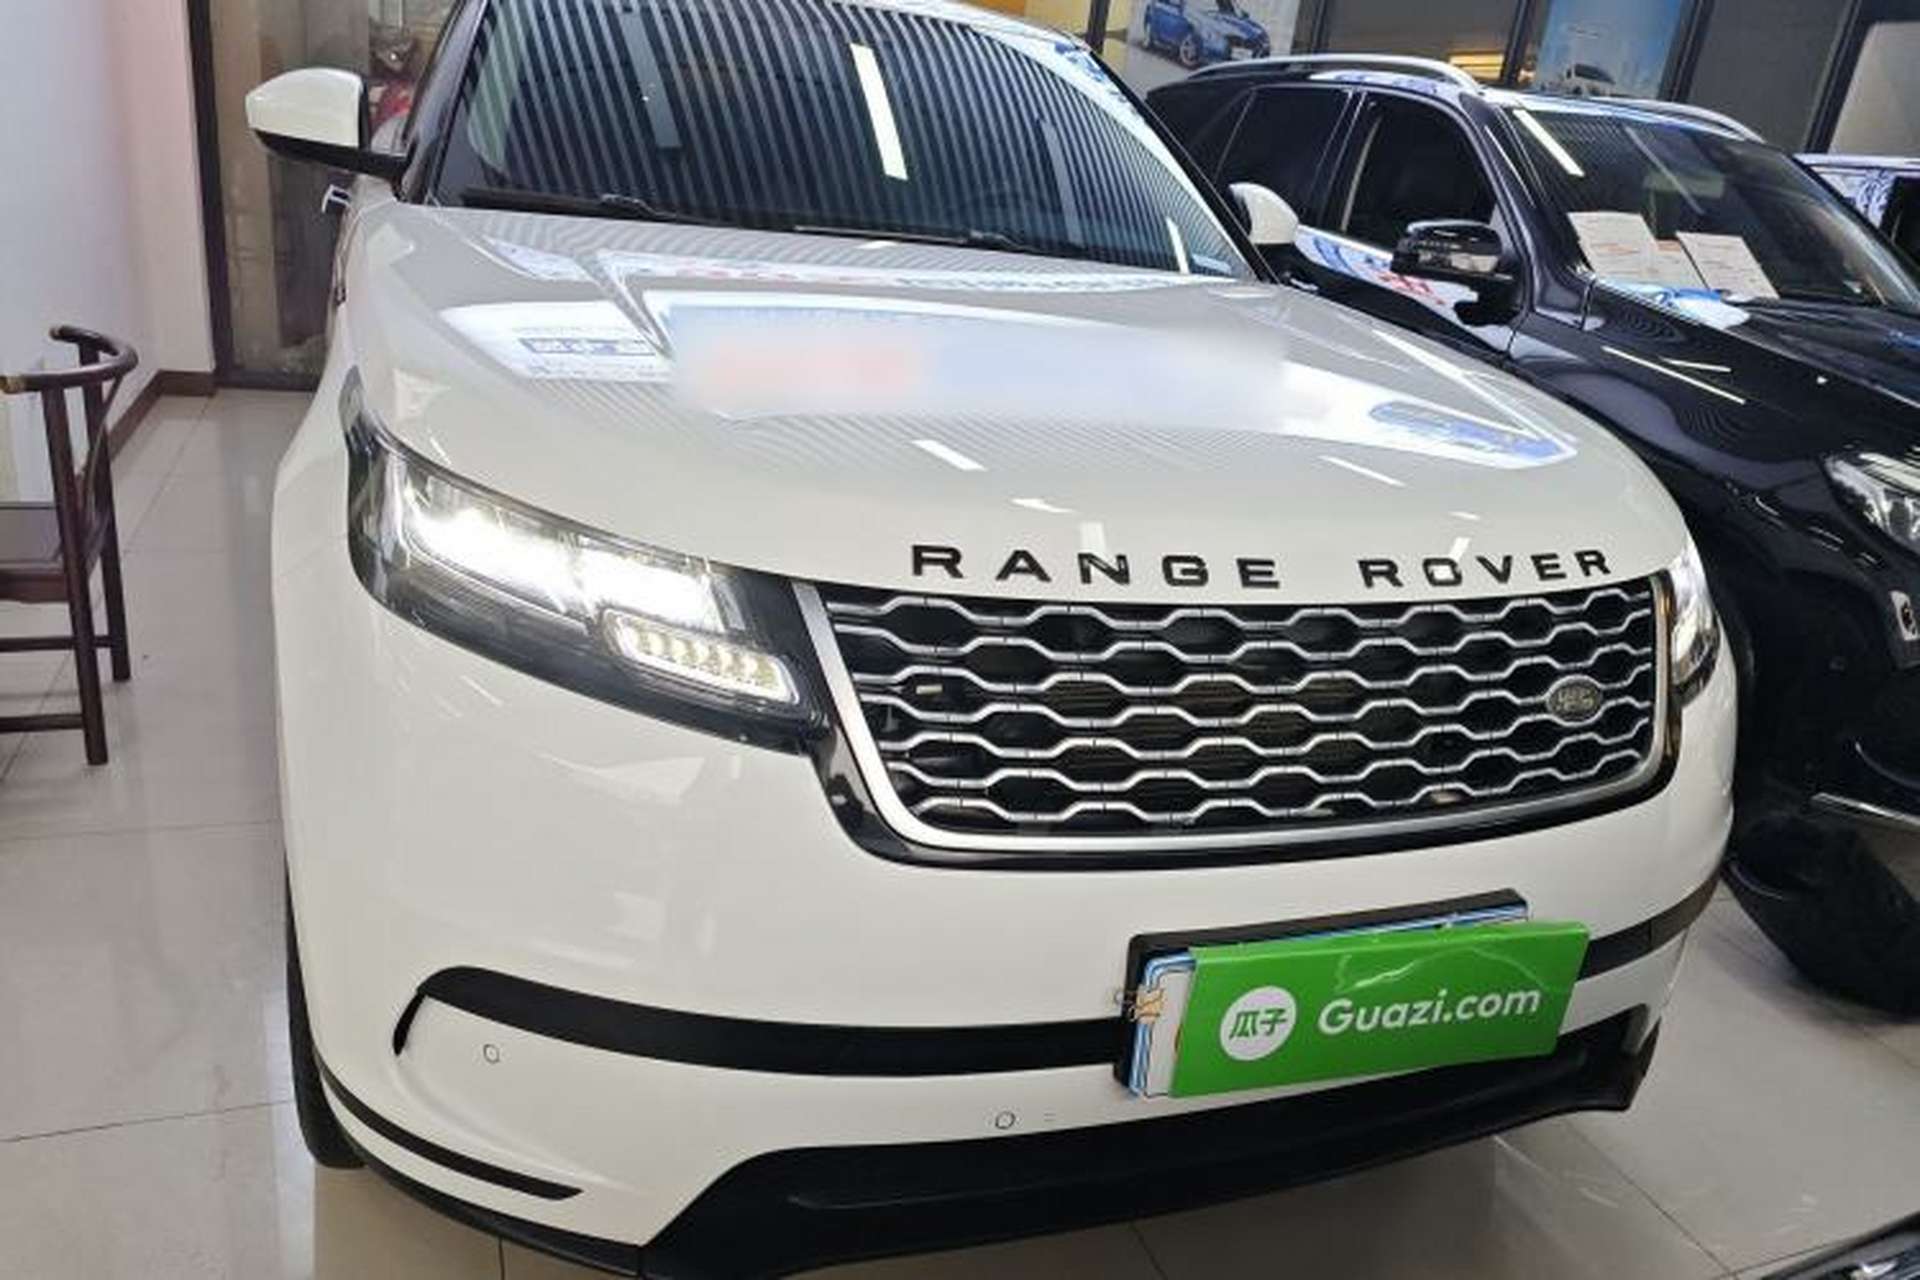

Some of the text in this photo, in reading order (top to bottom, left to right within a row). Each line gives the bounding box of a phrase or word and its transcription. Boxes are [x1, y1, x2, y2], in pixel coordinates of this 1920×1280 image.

[912, 544, 1611, 589] RANGE ROVER
[1231, 1009, 1288, 1038] 瓜子
[1318, 988, 1541, 1036] Guazi.com
